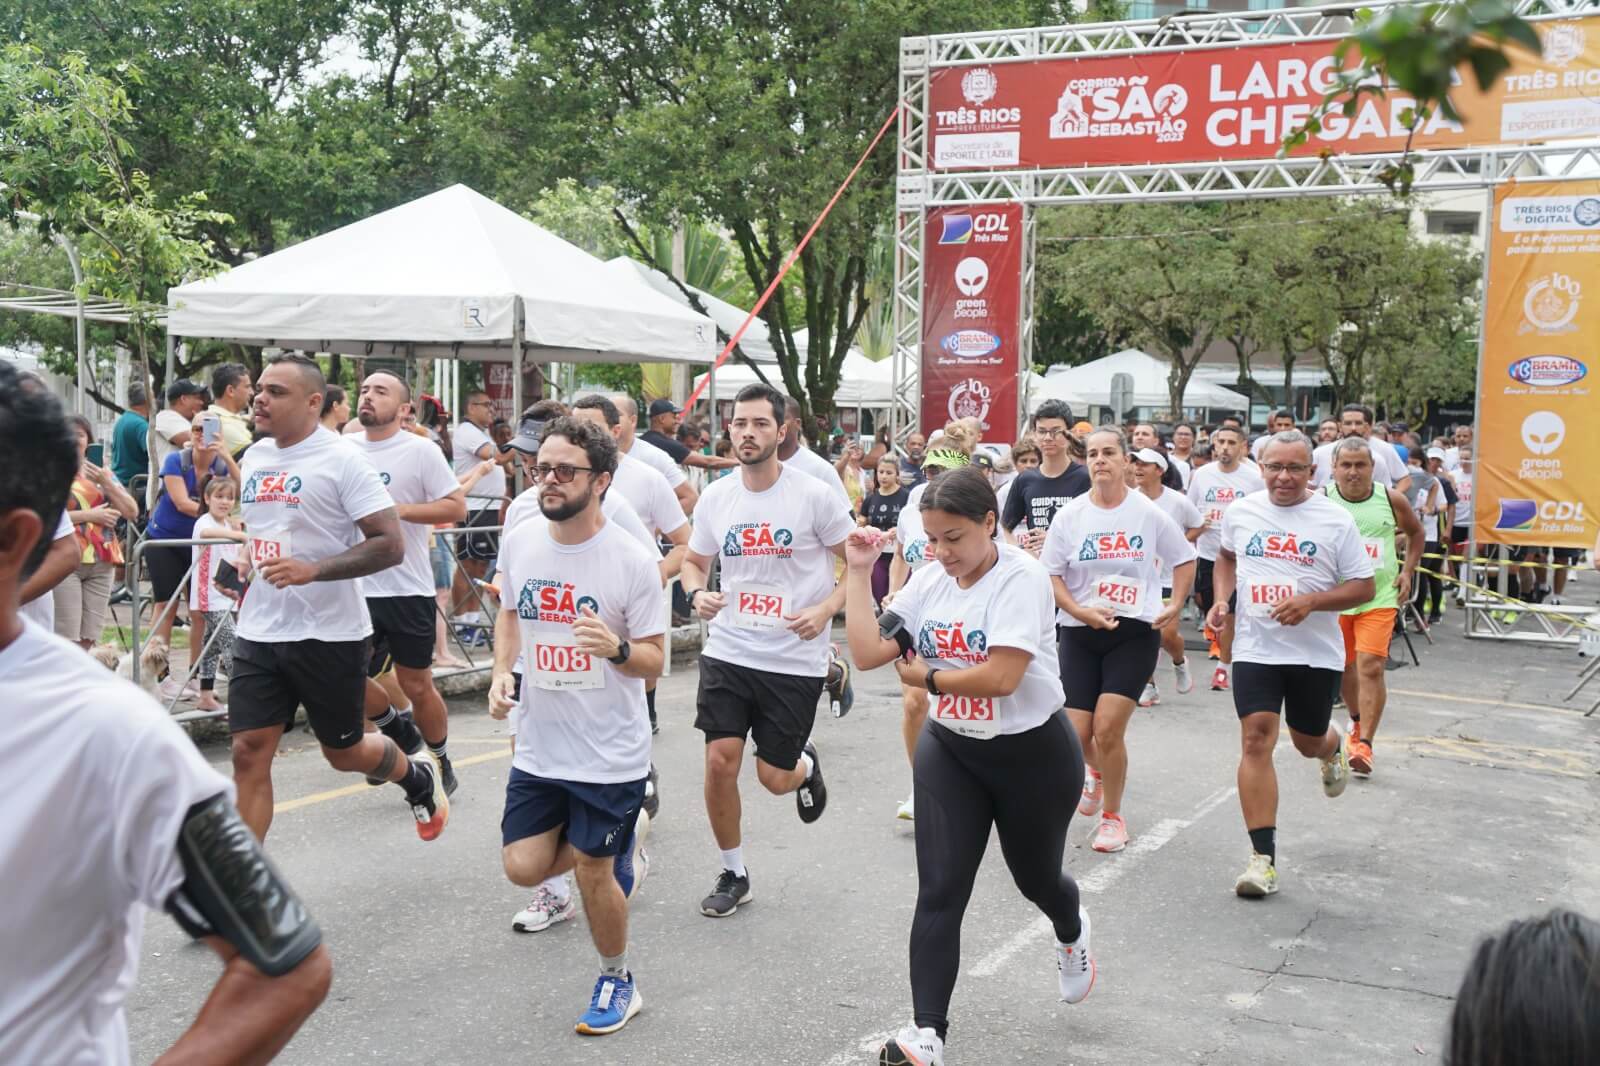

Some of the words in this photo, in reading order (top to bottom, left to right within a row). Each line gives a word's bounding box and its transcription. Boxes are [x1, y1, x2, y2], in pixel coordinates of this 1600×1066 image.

[1069, 77, 1126, 89] CORRIDA
[1210, 56, 1462, 102] LARG
[1504, 70, 1557, 92] TRÊS
[1079, 88, 1094, 97] DE
[936, 106, 977, 125] TRÊS
[980, 107, 1021, 123] RIOS
[953, 123, 1001, 132] PREFEITURA
[1089, 112, 1188, 137] SEBASTIÃO
[940, 151, 977, 161] ESPORTE
[979, 151, 985, 159] E
[1514, 203, 1542, 214] TRÊS
[1545, 204, 1572, 213] RIOS
[974, 213, 1009, 231] CDL
[1524, 214, 1570, 224] DIGITAL
[974, 233, 990, 242] Três
[991, 233, 1008, 242] Rios
[956, 299, 986, 310] green
[954, 306, 988, 319] people
[1532, 360, 1580, 370] BRAMIL
[968, 378, 990, 399] 100
[1522, 458, 1561, 470] green
[1519, 467, 1563, 481] people
[256, 494, 300, 504] SEBASTIÃO
[1539, 501, 1585, 521] CDL
[1540, 523, 1561, 532] Três
[1563, 524, 1585, 533] Rios
[742, 546, 793, 557] SEBASTIÃO
[1098, 551, 1144, 560] SEBASTIÃO
[527, 578, 562, 589] CORRIDA
[1098, 582, 1137, 605] 246
[1252, 584, 1294, 604] 180
[740, 592, 783, 618] 252
[538, 644, 591, 672] 008
[940, 695, 993, 720] 203
